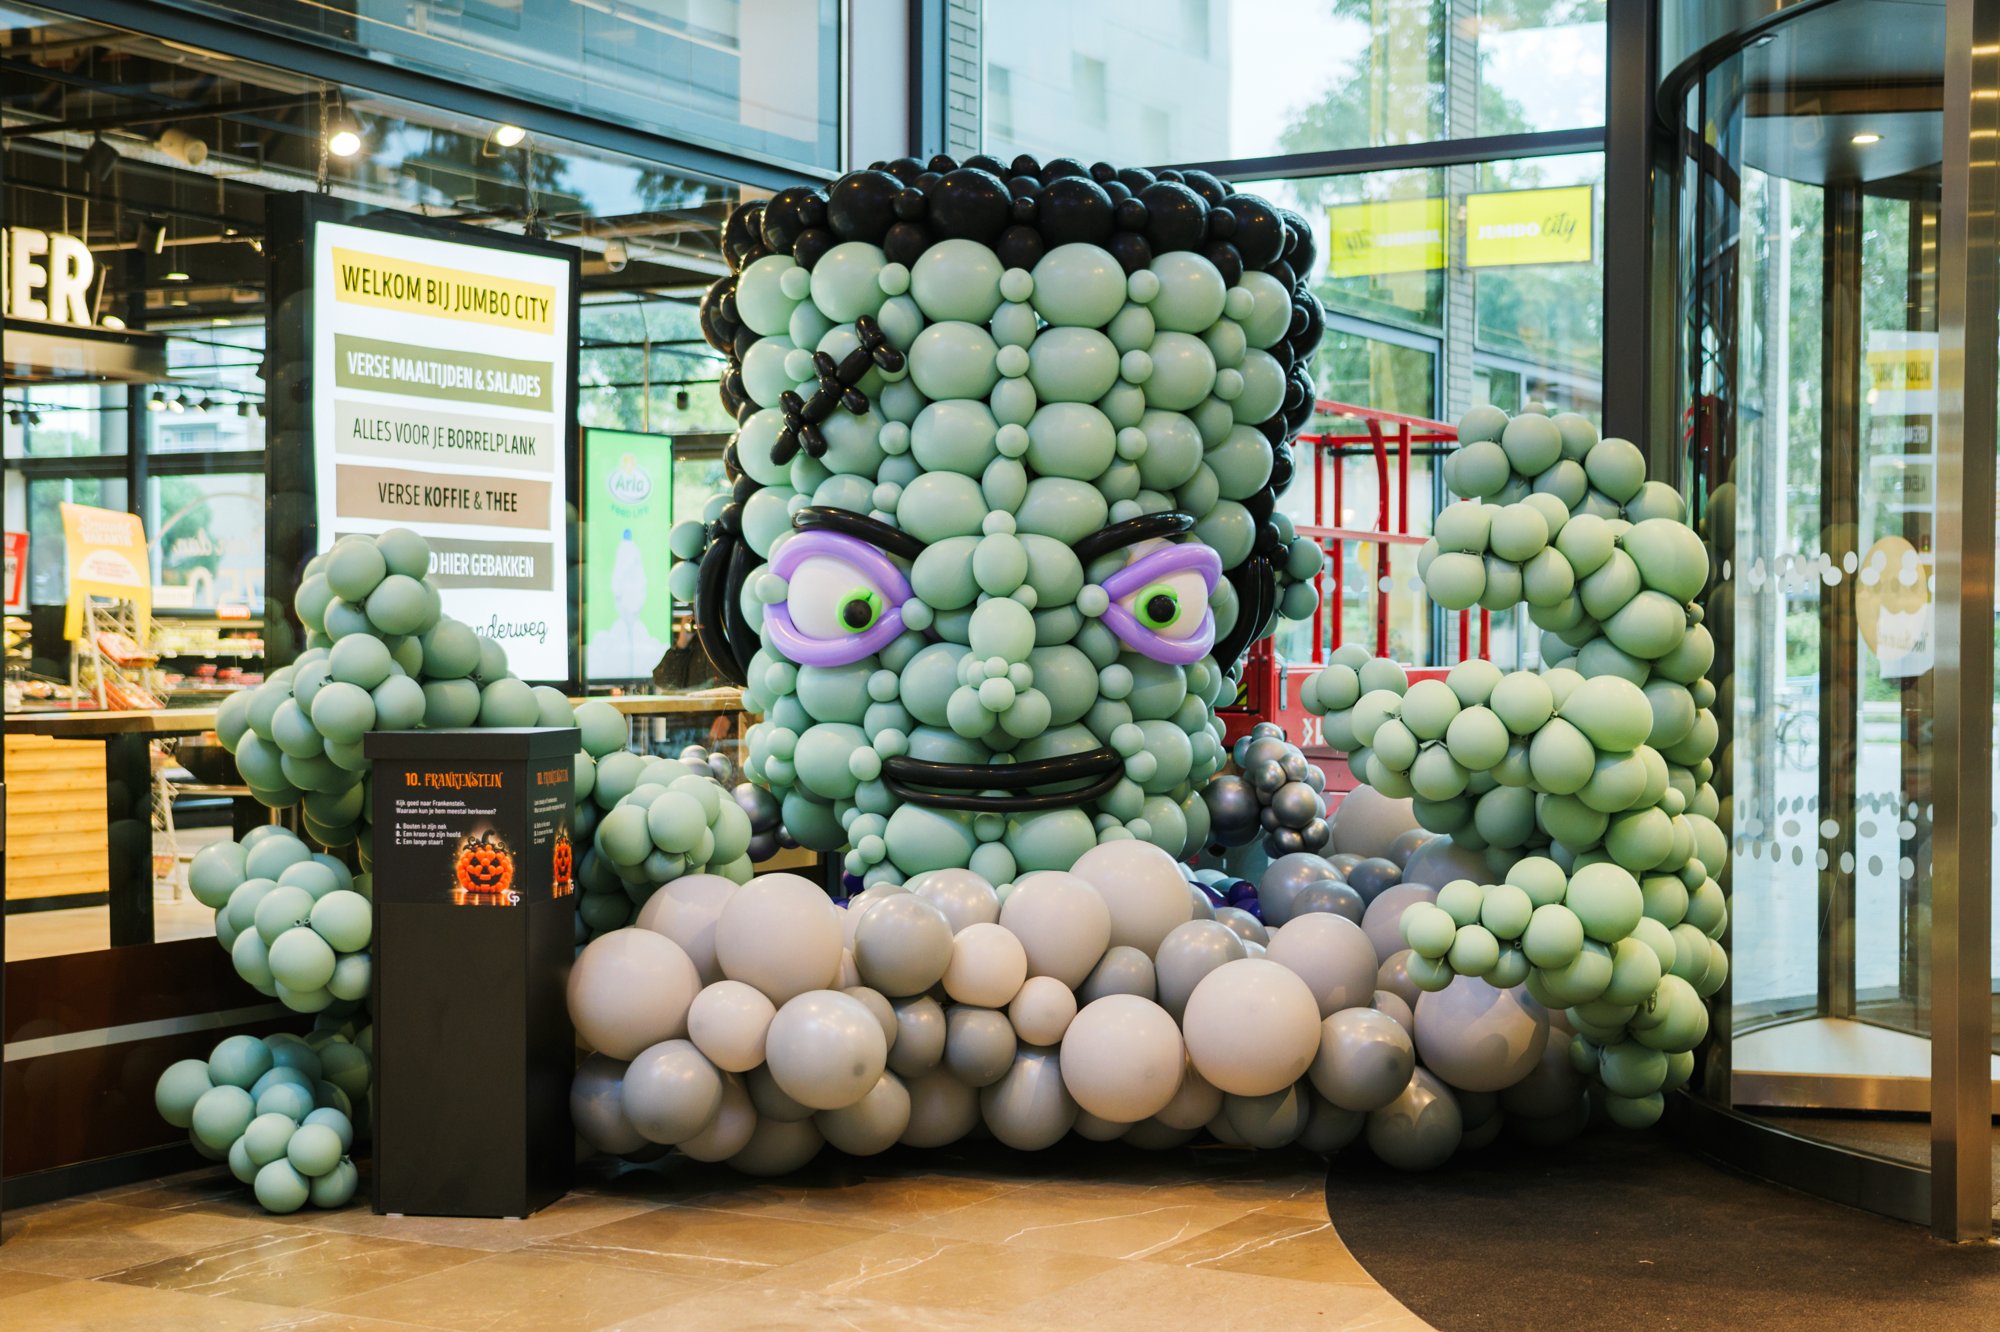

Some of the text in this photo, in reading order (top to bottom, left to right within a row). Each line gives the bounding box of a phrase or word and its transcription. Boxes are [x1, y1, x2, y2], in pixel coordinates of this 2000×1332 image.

[2, 226, 125, 330] ER.
[342, 264, 549, 323] WELKOM BIJ JUMBO CITY
[347, 351, 542, 398] VERSE MAALTIJDEN & SALADES
[353, 418, 536, 456] ALLES VOOR JE BORRELPLANK
[378, 482, 518, 513] VERSE KOFFIE & THEE
[615, 474, 646, 493] Arla
[439, 552, 470, 575] HIER
[471, 553, 535, 578] GEBAKKEN
[475, 613, 548, 645] nderweg
[405, 771, 504, 790] 10. FRANKENSTEIN
[427, 823, 437, 831] zijn
[436, 831, 446, 839] zijn
